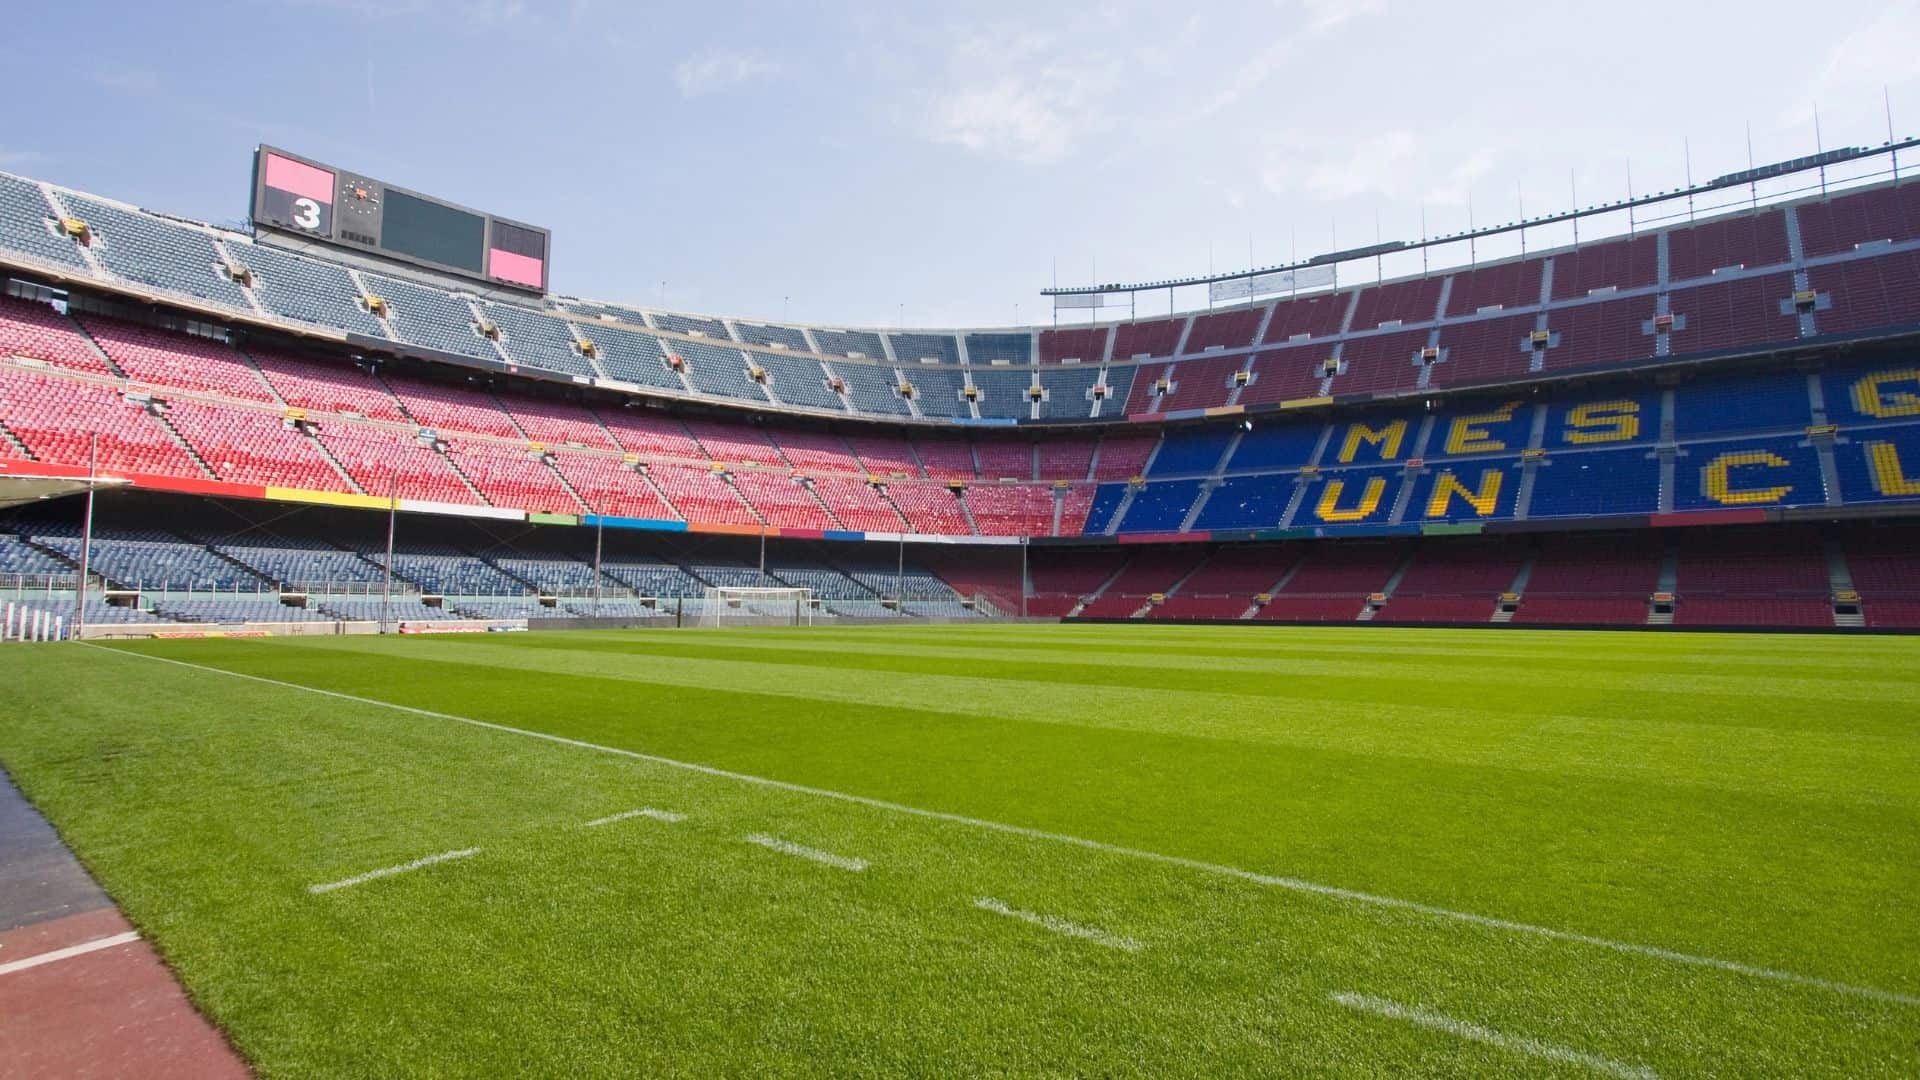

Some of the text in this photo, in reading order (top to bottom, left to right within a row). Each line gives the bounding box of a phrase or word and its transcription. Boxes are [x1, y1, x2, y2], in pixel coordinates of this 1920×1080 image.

[294, 198, 321, 229] 3
[1338, 401, 1640, 463] MÉS
[1316, 471, 1503, 522] UN
